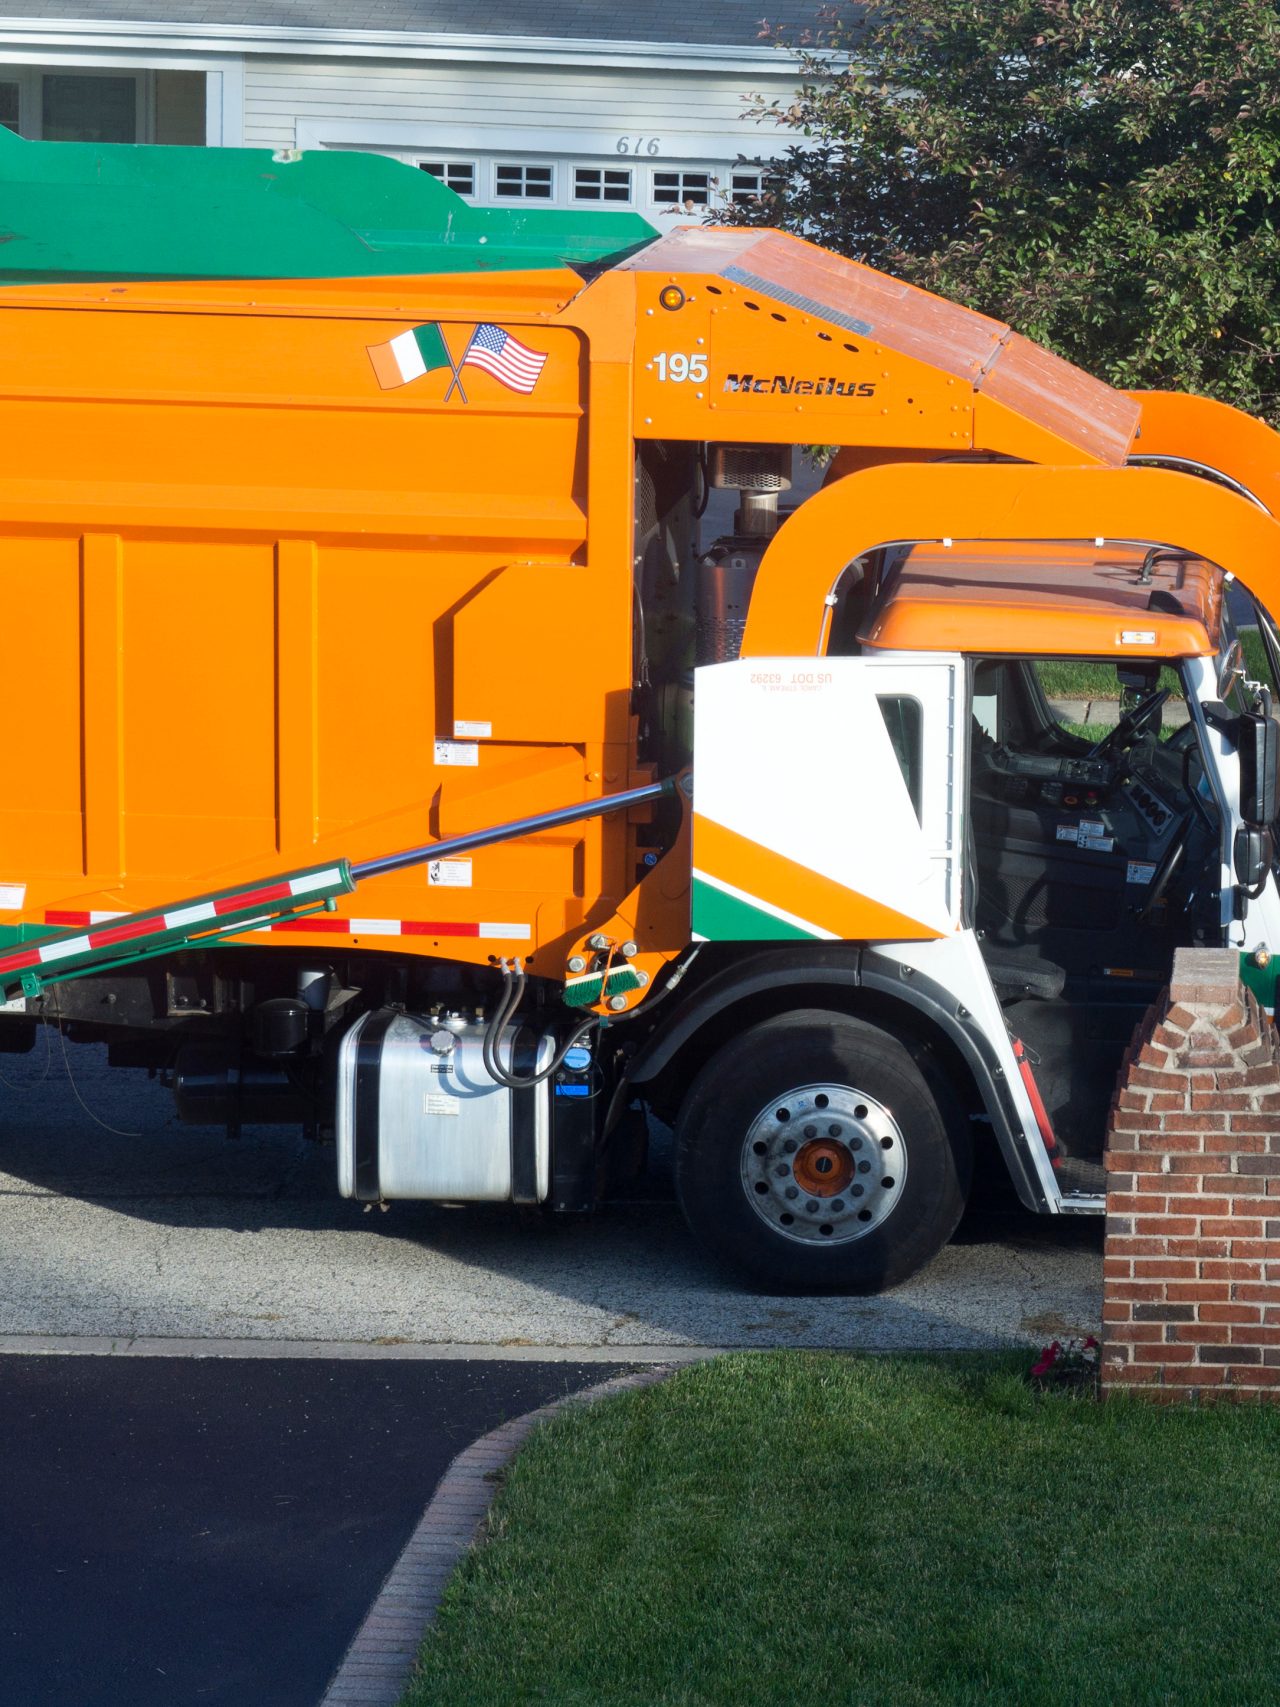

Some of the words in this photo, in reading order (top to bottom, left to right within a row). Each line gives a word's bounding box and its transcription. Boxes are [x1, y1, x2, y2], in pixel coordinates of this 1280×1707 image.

[616, 136, 660, 156] 616
[653, 352, 708, 383] 195
[722, 374, 876, 397] McNeilus
[791, 673, 814, 684] DOT
[817, 673, 832, 684] US
